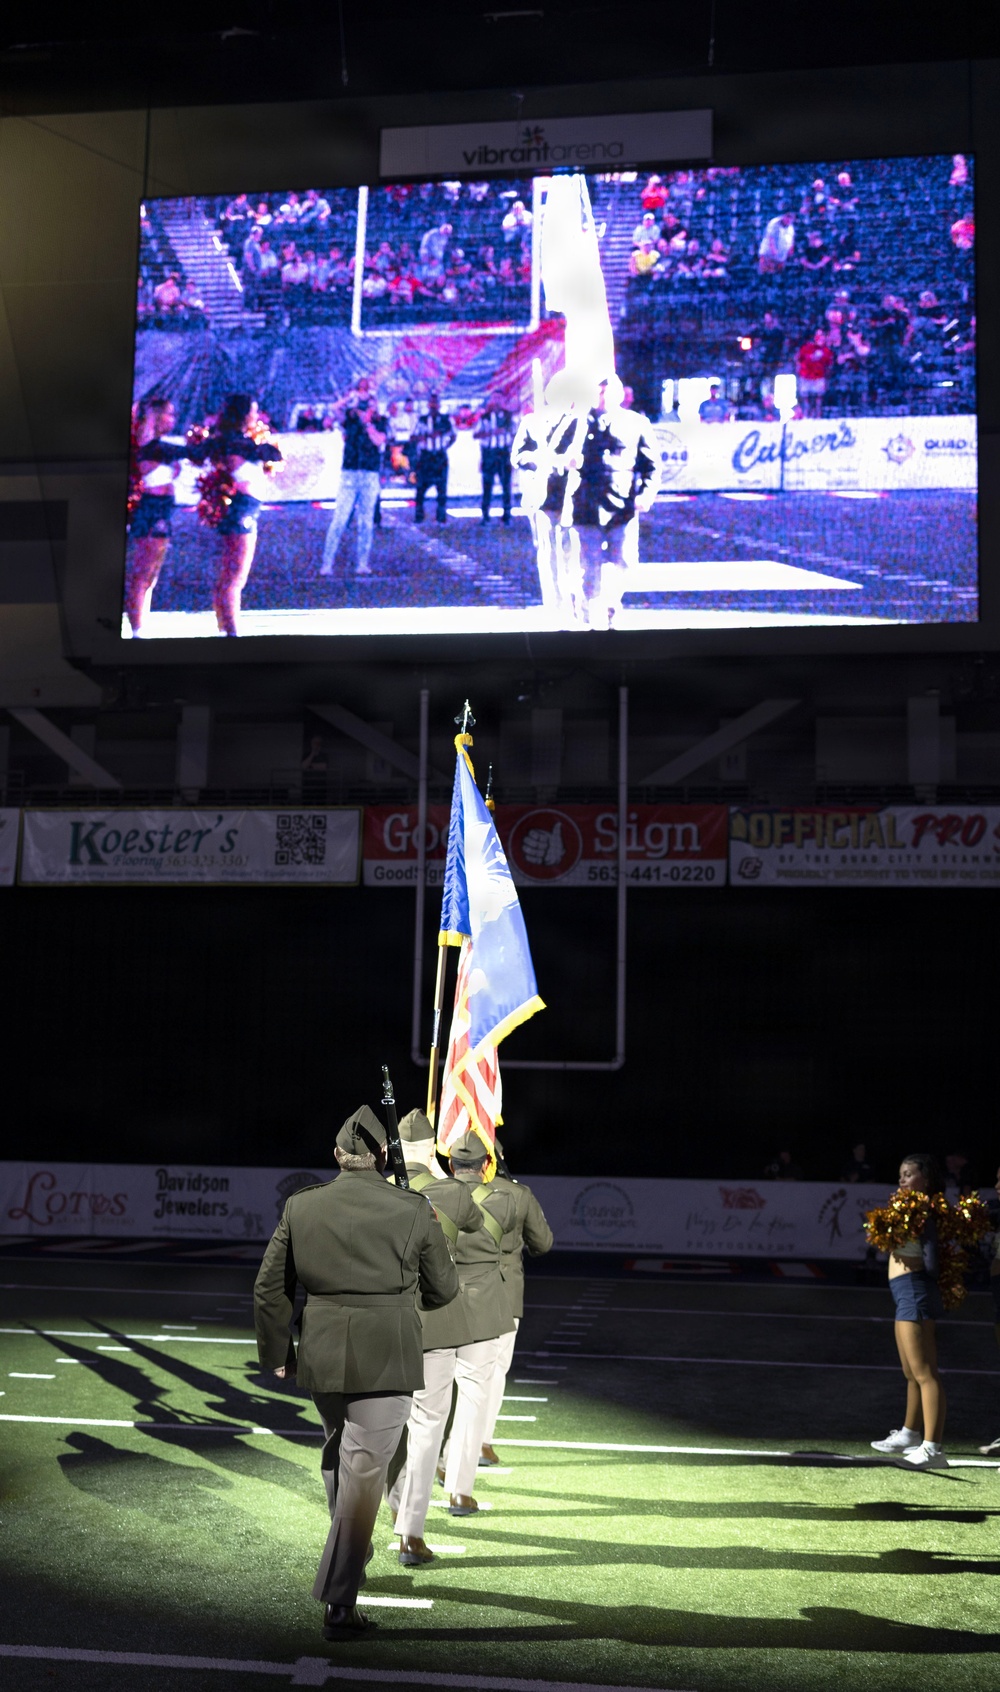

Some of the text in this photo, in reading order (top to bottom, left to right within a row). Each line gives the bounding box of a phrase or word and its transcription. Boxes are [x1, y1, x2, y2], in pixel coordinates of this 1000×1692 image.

[69, 815, 239, 866] Koester's
[593, 812, 701, 858] Sign
[748, 812, 906, 849] OFFICIAL
[911, 812, 988, 849] PRO
[112, 854, 250, 870] Flooring 563-323-3301
[588, 866, 716, 883] 563-441-0220
[155, 1168, 229, 1192] Davidson
[154, 1193, 229, 1219] Jewelers
